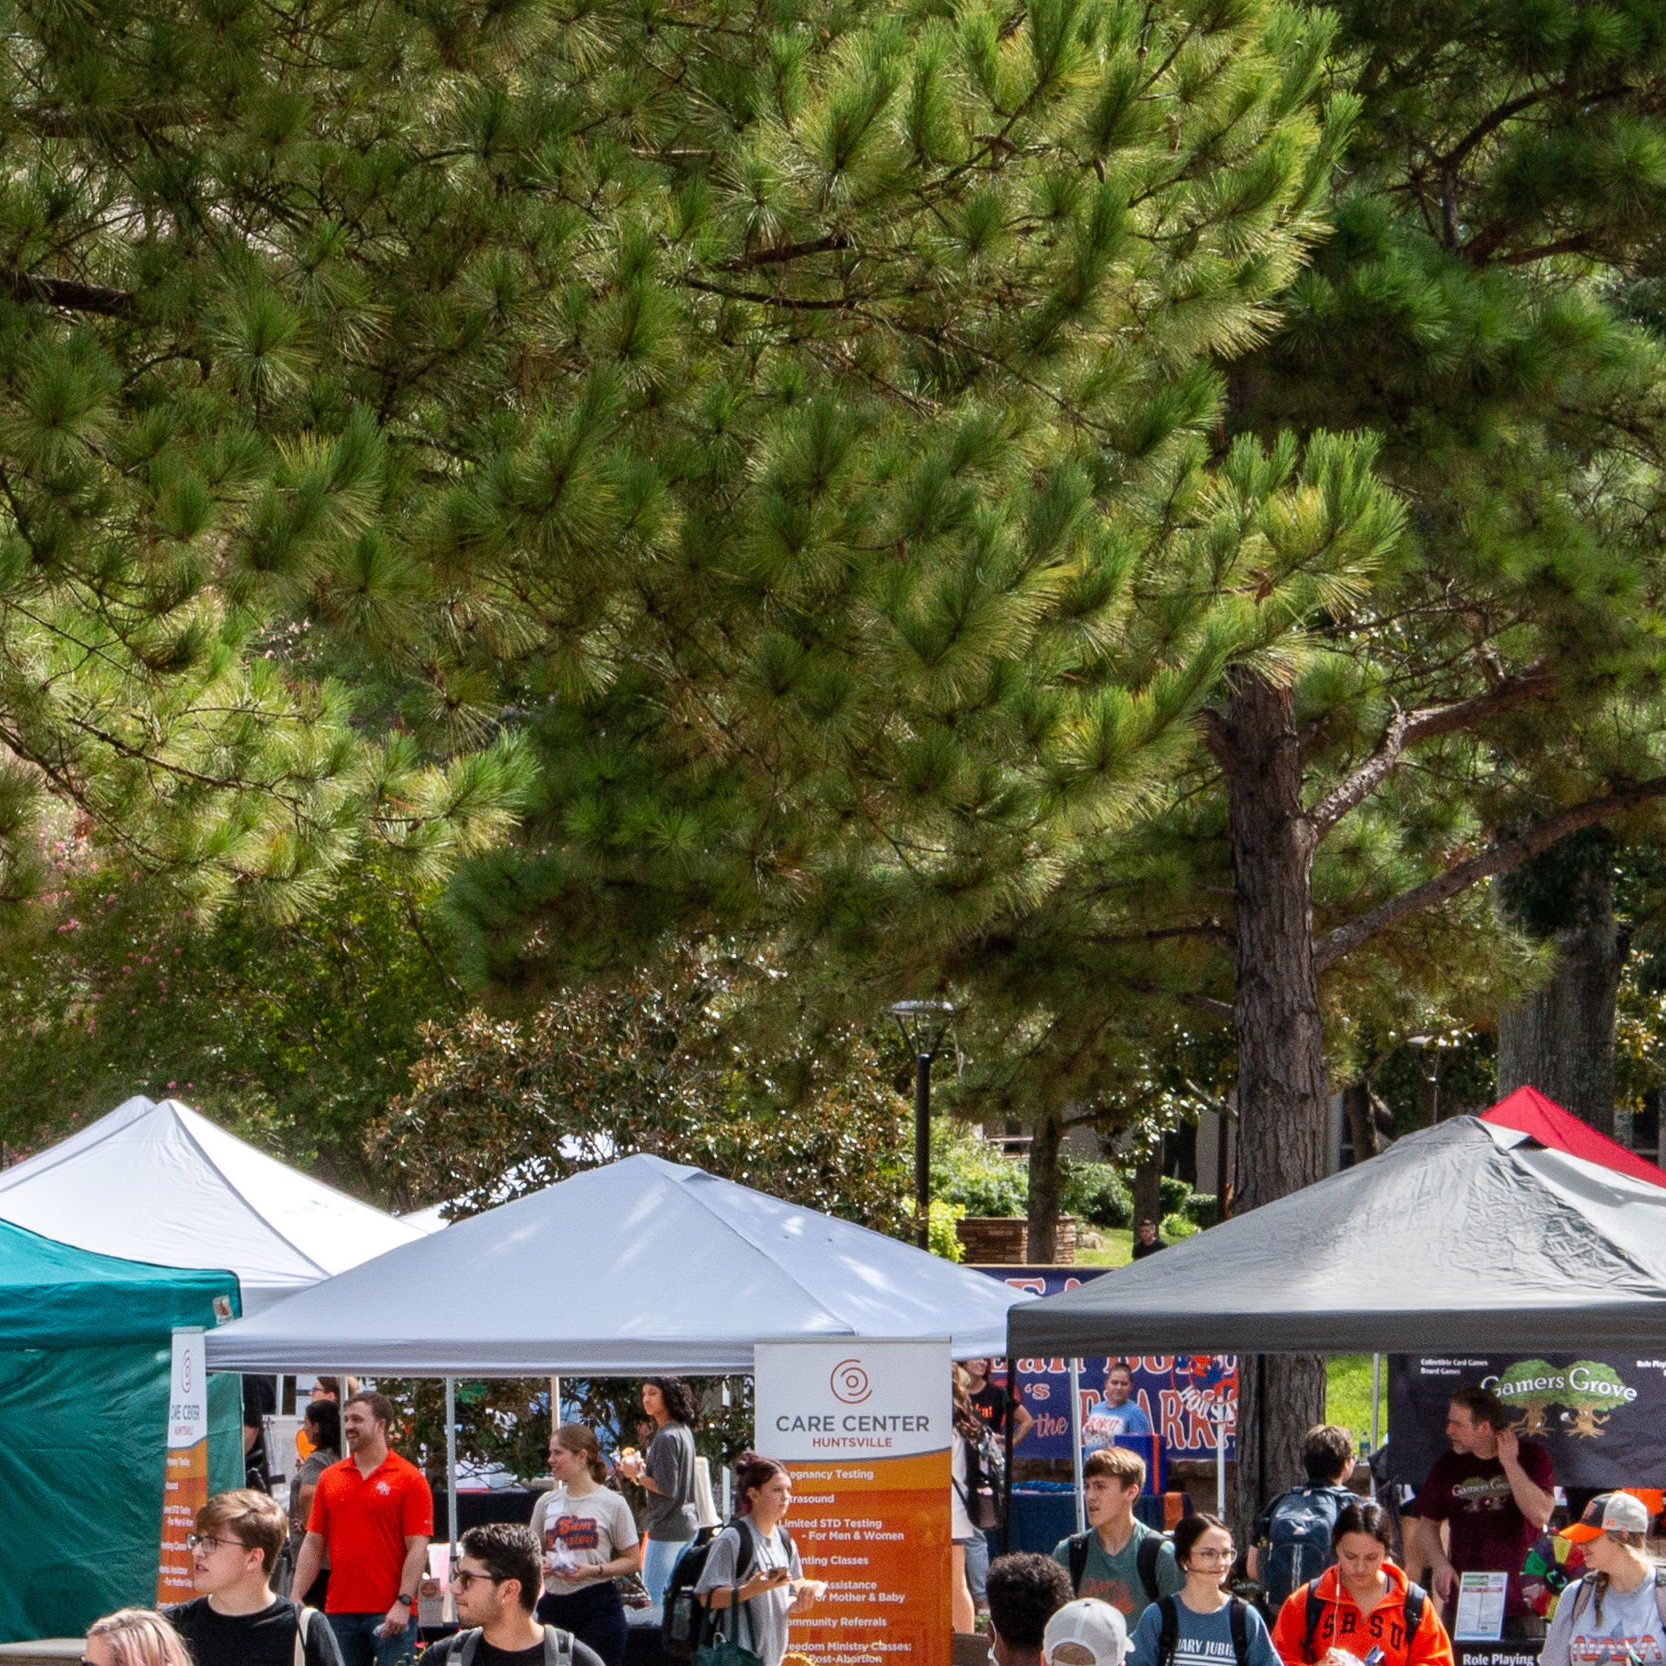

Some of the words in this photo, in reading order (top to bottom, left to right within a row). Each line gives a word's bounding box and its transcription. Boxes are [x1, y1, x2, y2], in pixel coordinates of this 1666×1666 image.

[1569, 1367, 1638, 1402] Grove
[775, 1415, 835, 1432] CARE
[842, 1415, 930, 1432] CENTER
[812, 1437, 893, 1448] HUNTSVILLE
[789, 1470, 833, 1481] egnancy
[835, 1469, 874, 1481] Testing
[788, 1494, 835, 1504] trasound
[779, 1518, 817, 1528] Limited
[819, 1518, 841, 1528] STD
[843, 1518, 883, 1530] Testing
[808, 1531, 827, 1541] For
[829, 1531, 851, 1541] Men
[853, 1531, 861, 1541] &
[863, 1531, 905, 1541] Women
[799, 1555, 828, 1566] nting
[830, 1555, 869, 1565] Classes
[815, 1593, 826, 1602] or
[829, 1592, 867, 1602] Mother
[868, 1592, 876, 1602] &
[878, 1592, 906, 1604] Baby
[786, 1617, 838, 1628] ommunity
[840, 1617, 887, 1627] Referrals
[1321, 1611, 1404, 1651] SHSU
[787, 1642, 825, 1652] reedom
[827, 1642, 869, 1654] Ministry
[871, 1642, 913, 1652] Classes:
[1571, 1634, 1663, 1662] NASA
[1462, 1653, 1490, 1666] Role
